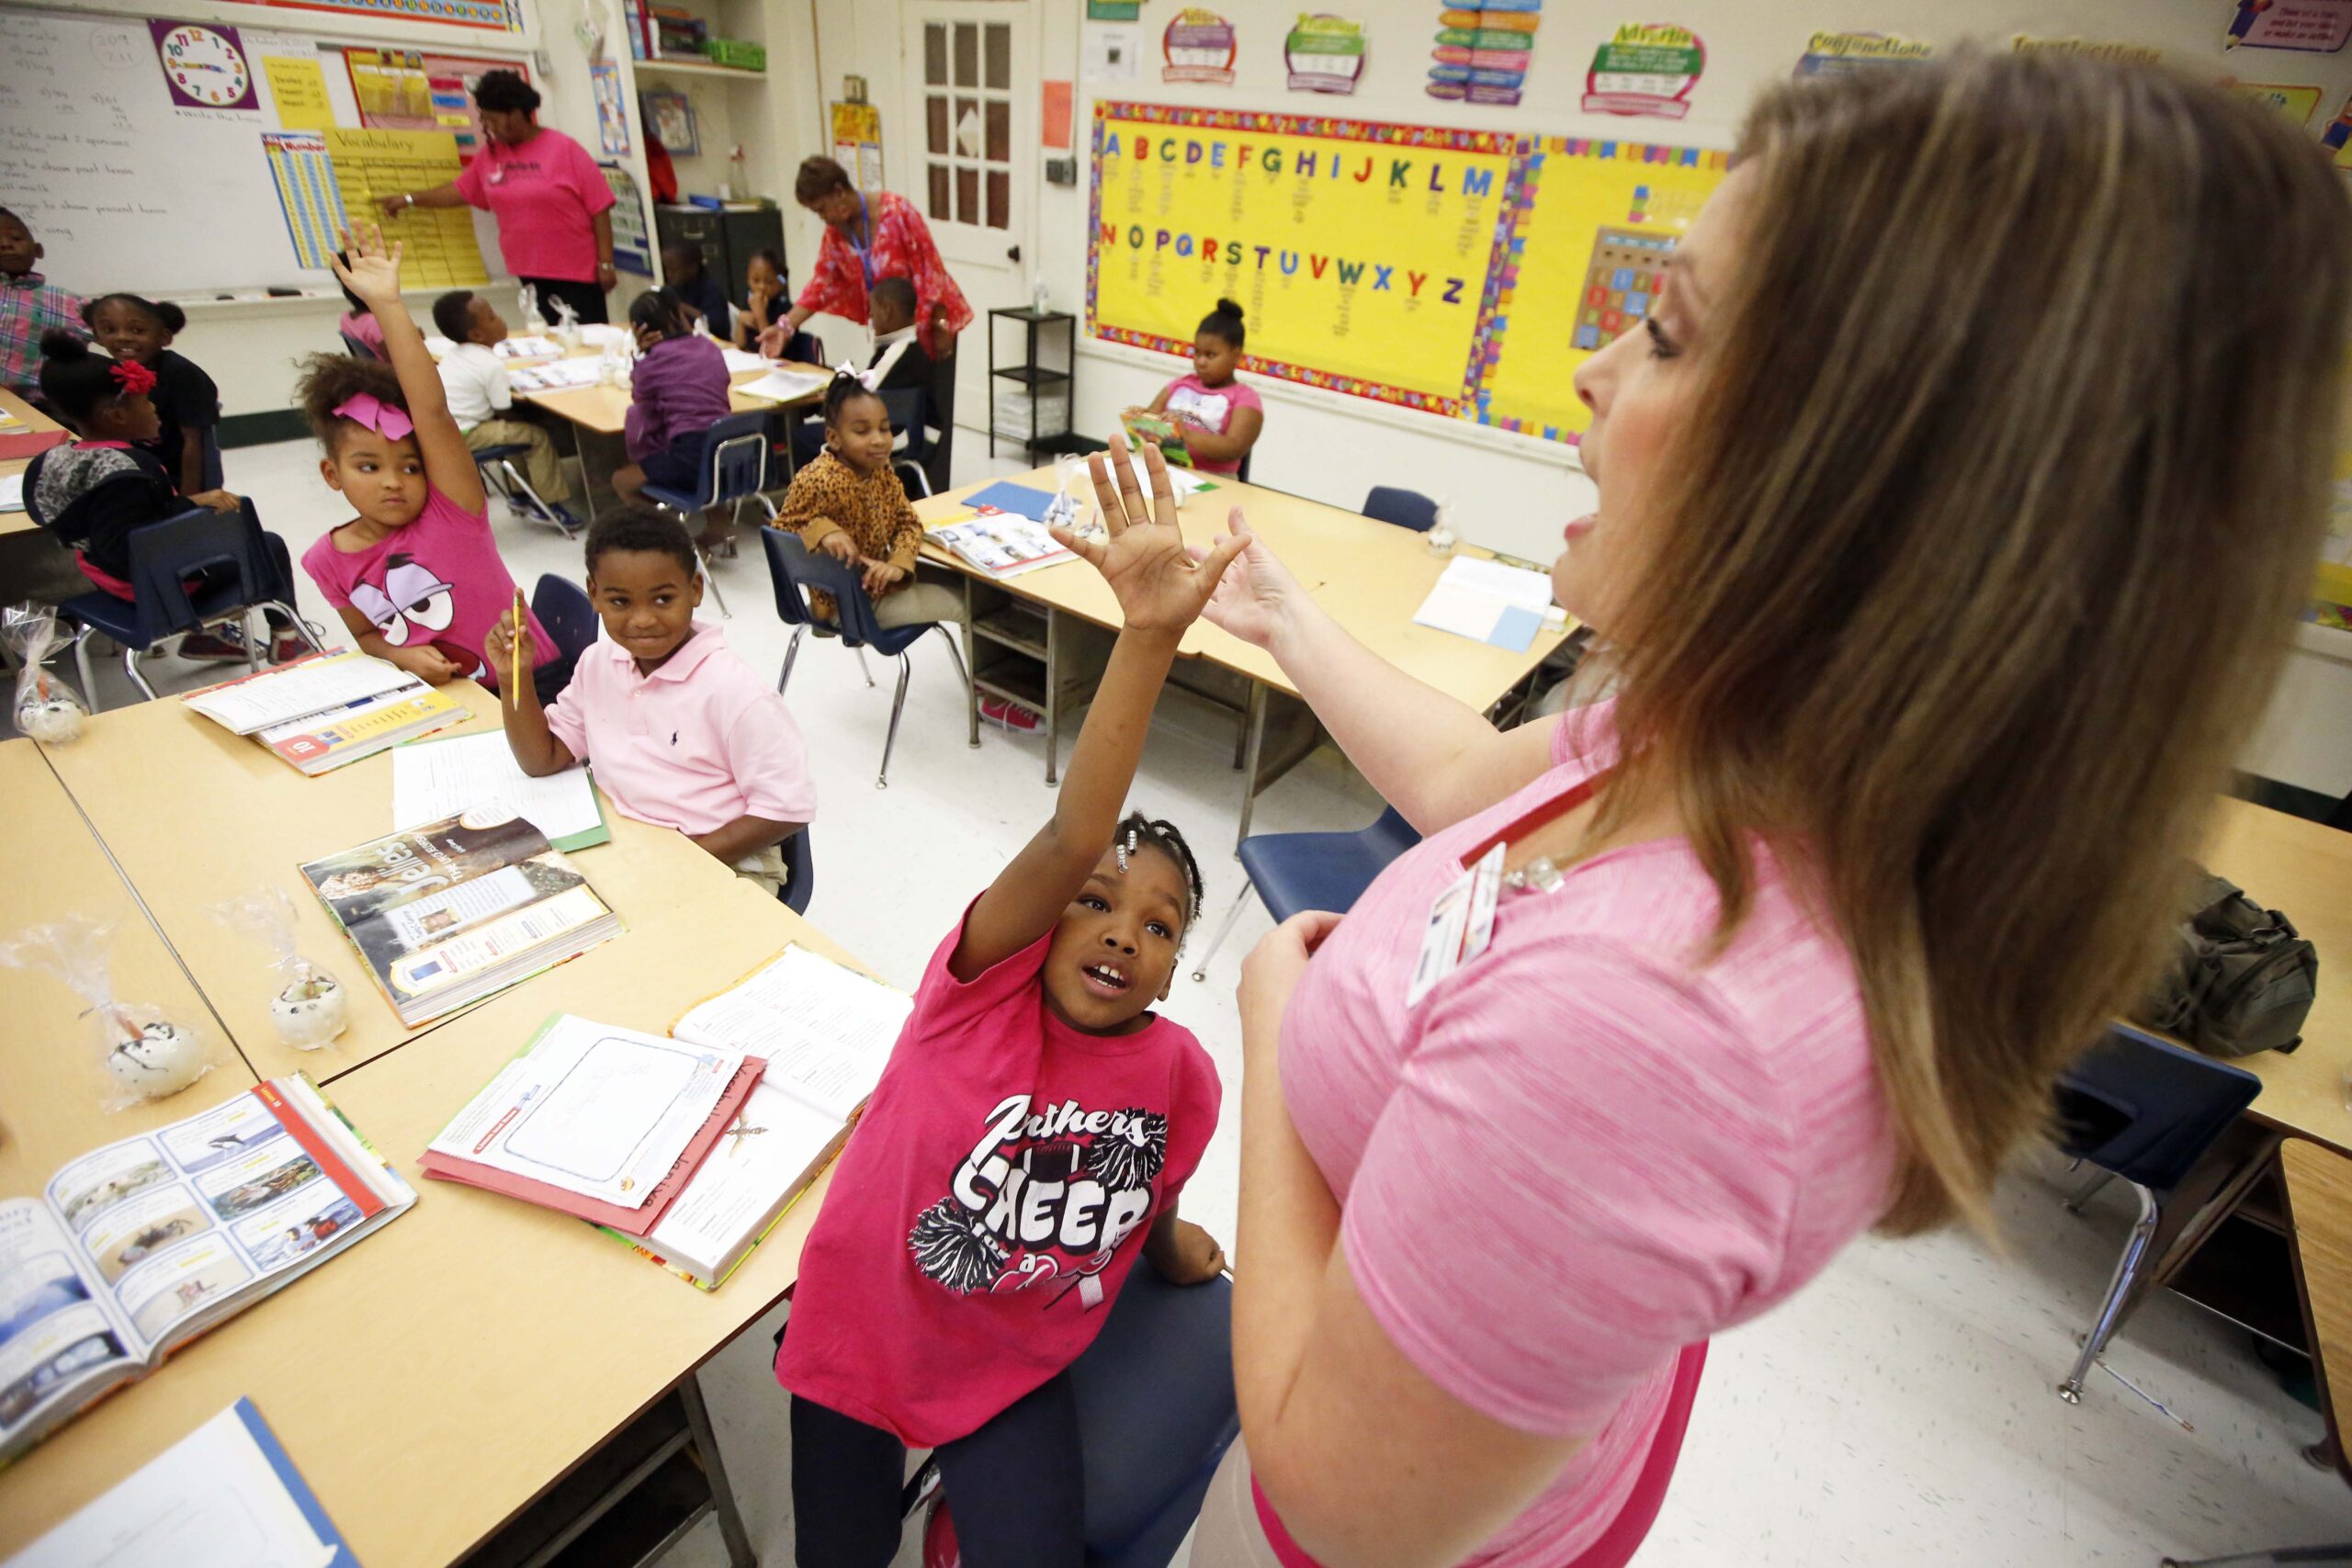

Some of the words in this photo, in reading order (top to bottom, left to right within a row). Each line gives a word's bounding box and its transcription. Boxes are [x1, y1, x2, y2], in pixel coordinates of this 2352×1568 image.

[175, 33, 189, 47] 11
[188, 28, 205, 42] 12
[166, 43, 183, 56] 10
[211, 37, 220, 49] 1
[1808, 31, 1933, 57] Conjunctions
[225, 48, 234, 60] 2
[167, 57, 177, 70] 9
[234, 62, 243, 74] 3
[176, 73, 187, 85] 8
[234, 76, 243, 87] 4
[192, 85, 201, 96] 7
[210, 90, 220, 103] 6
[226, 86, 235, 99] 5
[334, 131, 414, 154] Vocabulary
[1104, 133, 1120, 156] A
[1134, 135, 1148, 161] B
[1160, 138, 1176, 162] C
[1185, 140, 1203, 164] D
[1210, 142, 1227, 168] E
[1238, 144, 1253, 169] F
[1262, 148, 1283, 173] G
[1295, 151, 1317, 177] H
[1331, 152, 1340, 179] I
[1353, 156, 1374, 183] J
[1389, 159, 1411, 188] K
[1429, 164, 1445, 192] L
[1463, 167, 1493, 197] M
[1101, 222, 1116, 245] N
[1128, 224, 1144, 249] O
[1156, 229, 1170, 252] P
[1176, 233, 1193, 257] Q
[1202, 237, 1218, 264] R
[1226, 242, 1242, 265] S
[1254, 245, 1271, 269] T
[1280, 250, 1298, 275] U
[1310, 253, 1329, 279] V
[1338, 258, 1365, 285] W
[1373, 264, 1394, 290] X
[1408, 269, 1428, 296] Y
[1442, 277, 1464, 304] Z
[292, 741, 316, 753] 10
[376, 841, 449, 896] Jellies
[970, 1094, 1150, 1168] Pnthers
[950, 1153, 1150, 1256] CHEER
[1019, 1253, 1037, 1273] a
